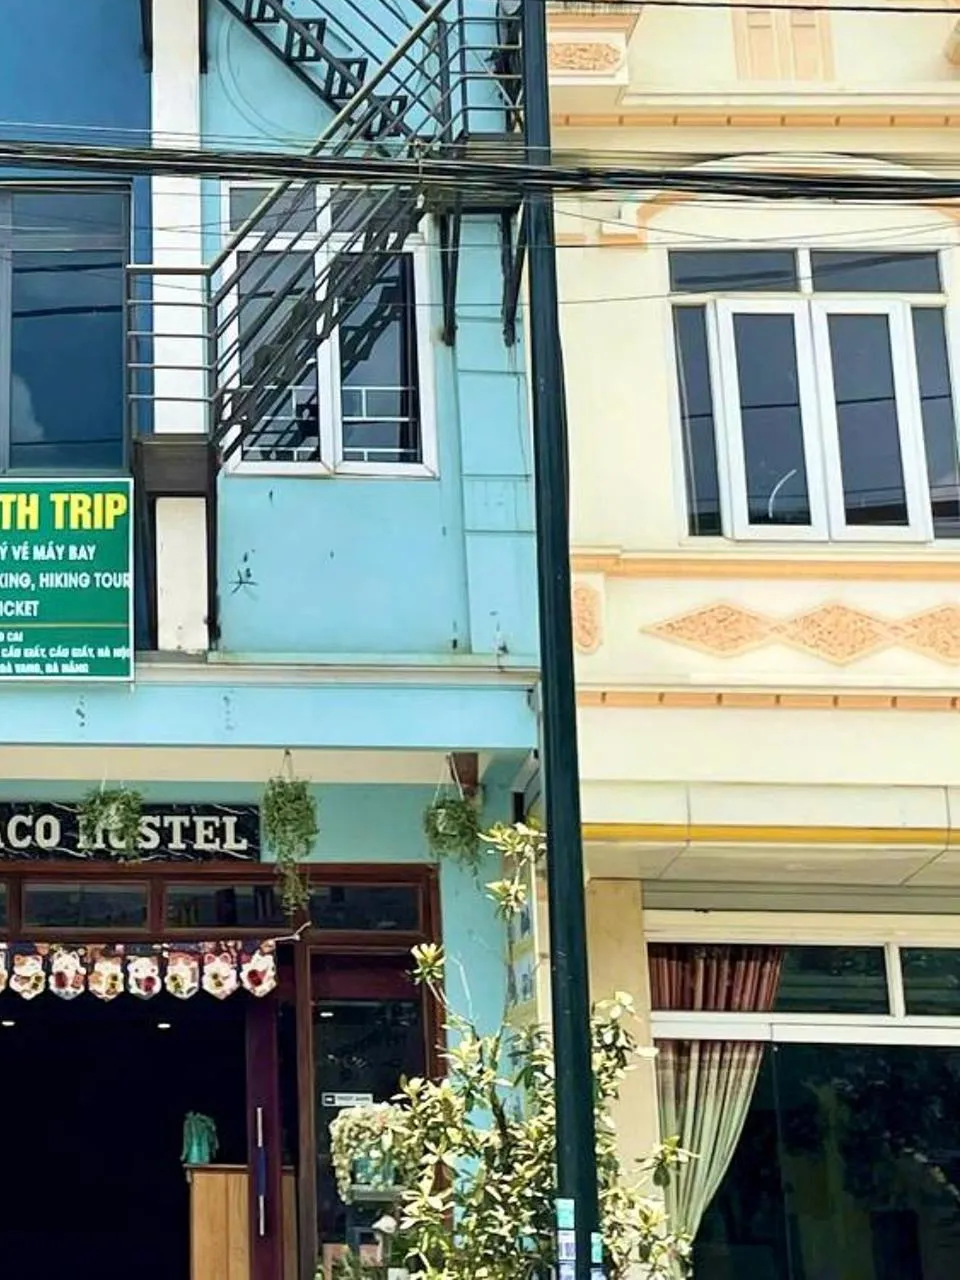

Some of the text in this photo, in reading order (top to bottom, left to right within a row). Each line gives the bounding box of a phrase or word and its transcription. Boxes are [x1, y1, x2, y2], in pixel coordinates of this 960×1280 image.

[50, 493, 128, 530] TRIP
[33, 542, 64, 560] MÁY
[68, 545, 96, 560] BAY
[39, 572, 90, 588] HIKING
